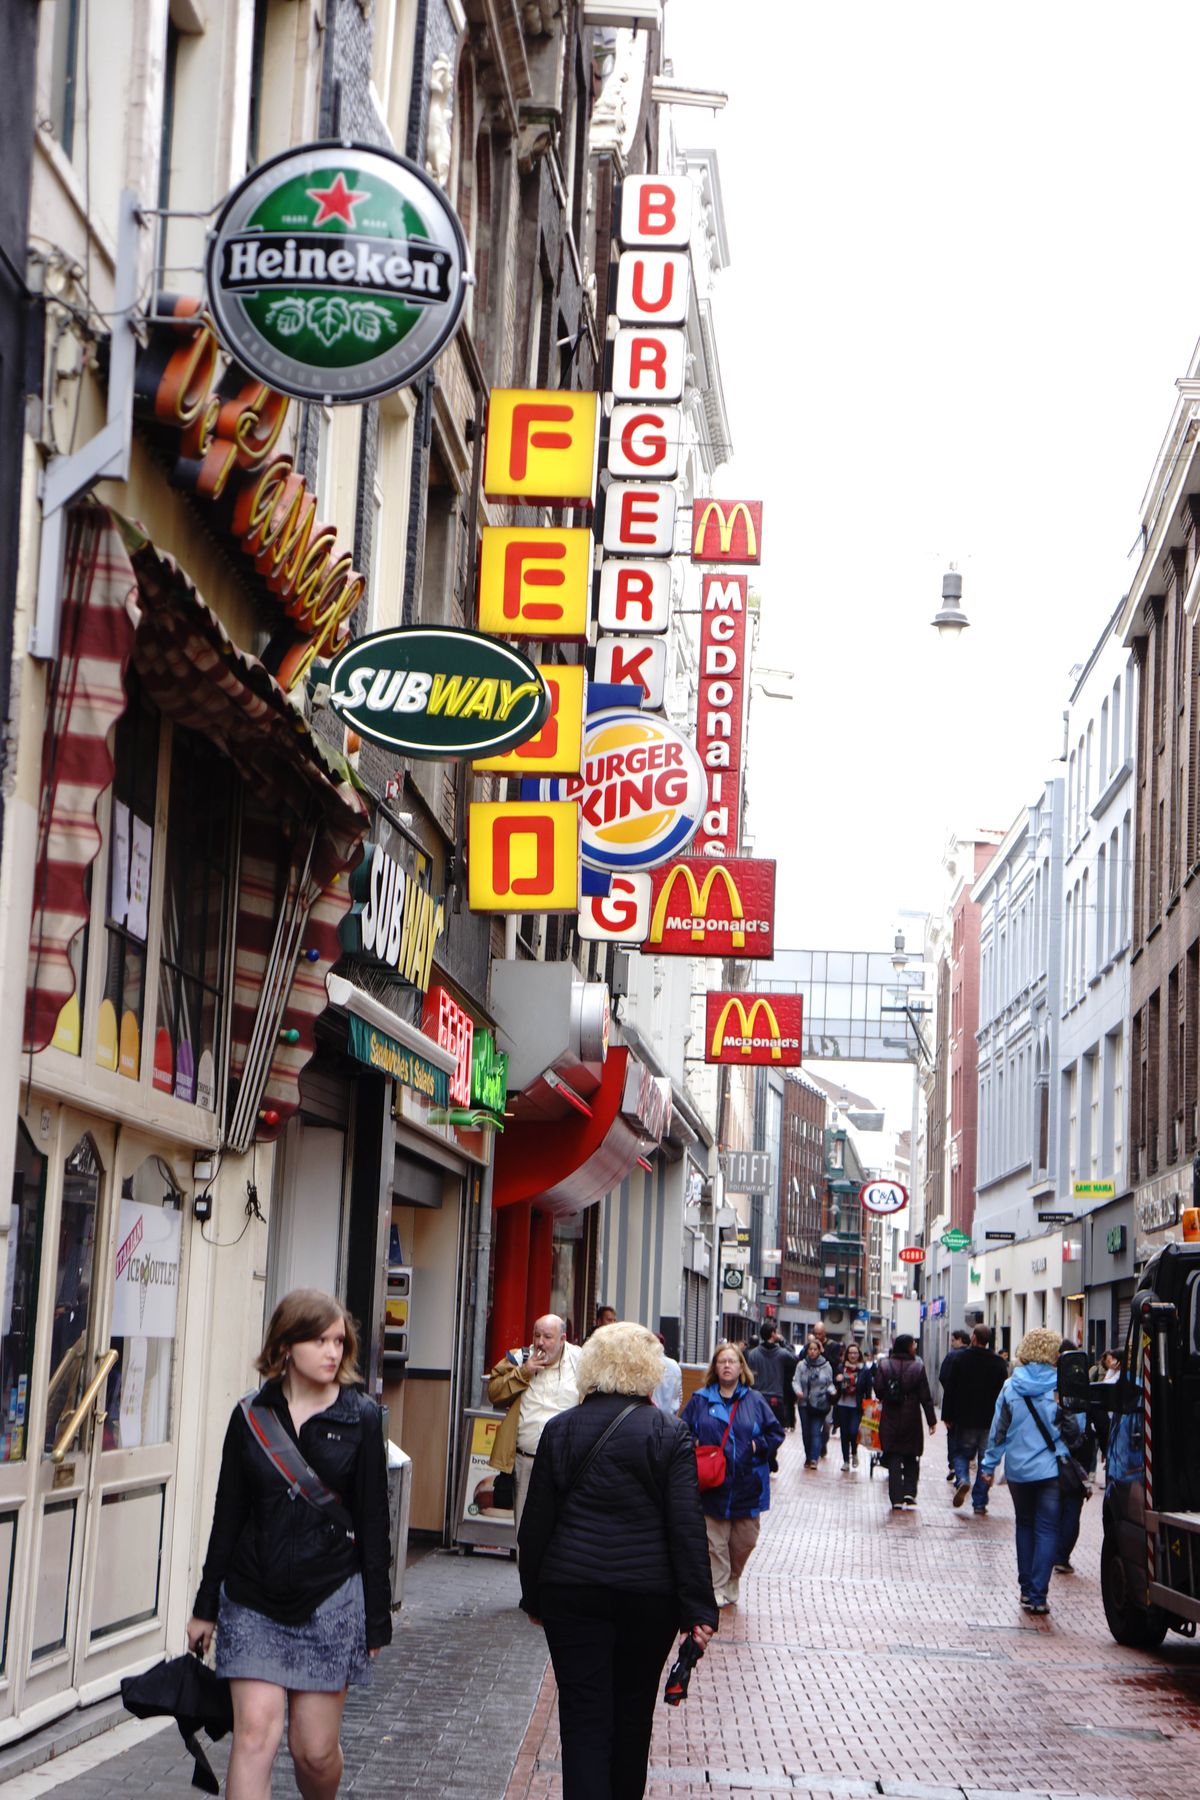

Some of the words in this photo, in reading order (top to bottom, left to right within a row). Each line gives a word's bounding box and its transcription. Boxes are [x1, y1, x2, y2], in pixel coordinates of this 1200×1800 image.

[229, 239, 441, 293] Heineken
[240, 331, 322, 387] PREMIUM
[338, 342, 420, 387] QUALITY
[614, 183, 677, 622] BURGER
[331, 666, 543, 722] SUBWAY
[577, 768, 688, 828] KING
[361, 843, 445, 994] SUBWAY
[666, 916, 770, 933] McDonald's
[723, 1035, 799, 1049] McDonald's
[728, 1153, 769, 1184] TAFT
[868, 1188, 899, 1205] C&A
[127, 1257, 140, 1282] ICE
[150, 1260, 178, 1286] OUTLET
